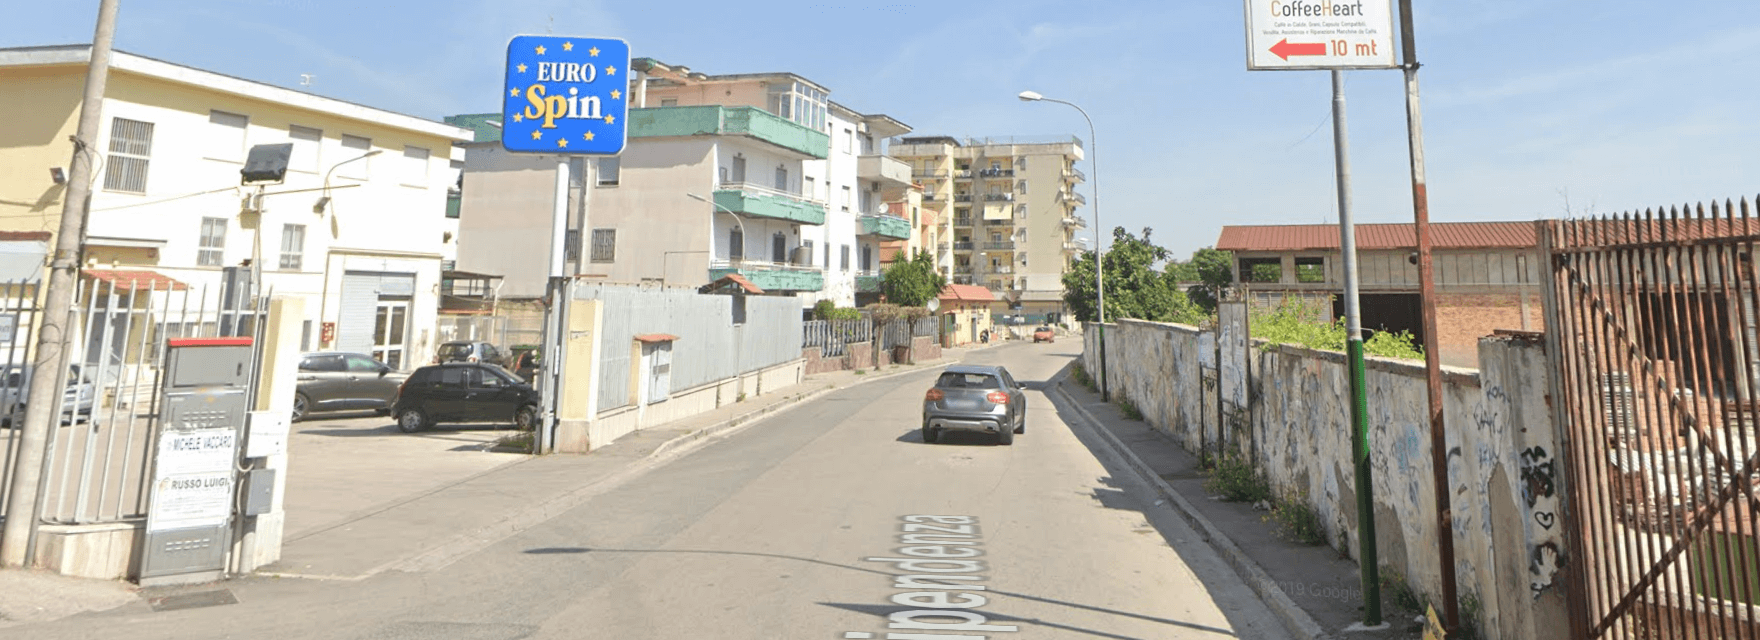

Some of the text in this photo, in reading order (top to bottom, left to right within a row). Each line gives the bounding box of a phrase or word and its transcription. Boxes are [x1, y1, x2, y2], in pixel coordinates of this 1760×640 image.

[1271, 0, 1363, 17] CoffeeHeart
[1331, 39, 1377, 56] 10 mt
[537, 61, 597, 83] EURO
[524, 84, 603, 129] Spin
[173, 436, 202, 451] MICHELE
[171, 479, 202, 490] RUSSO
